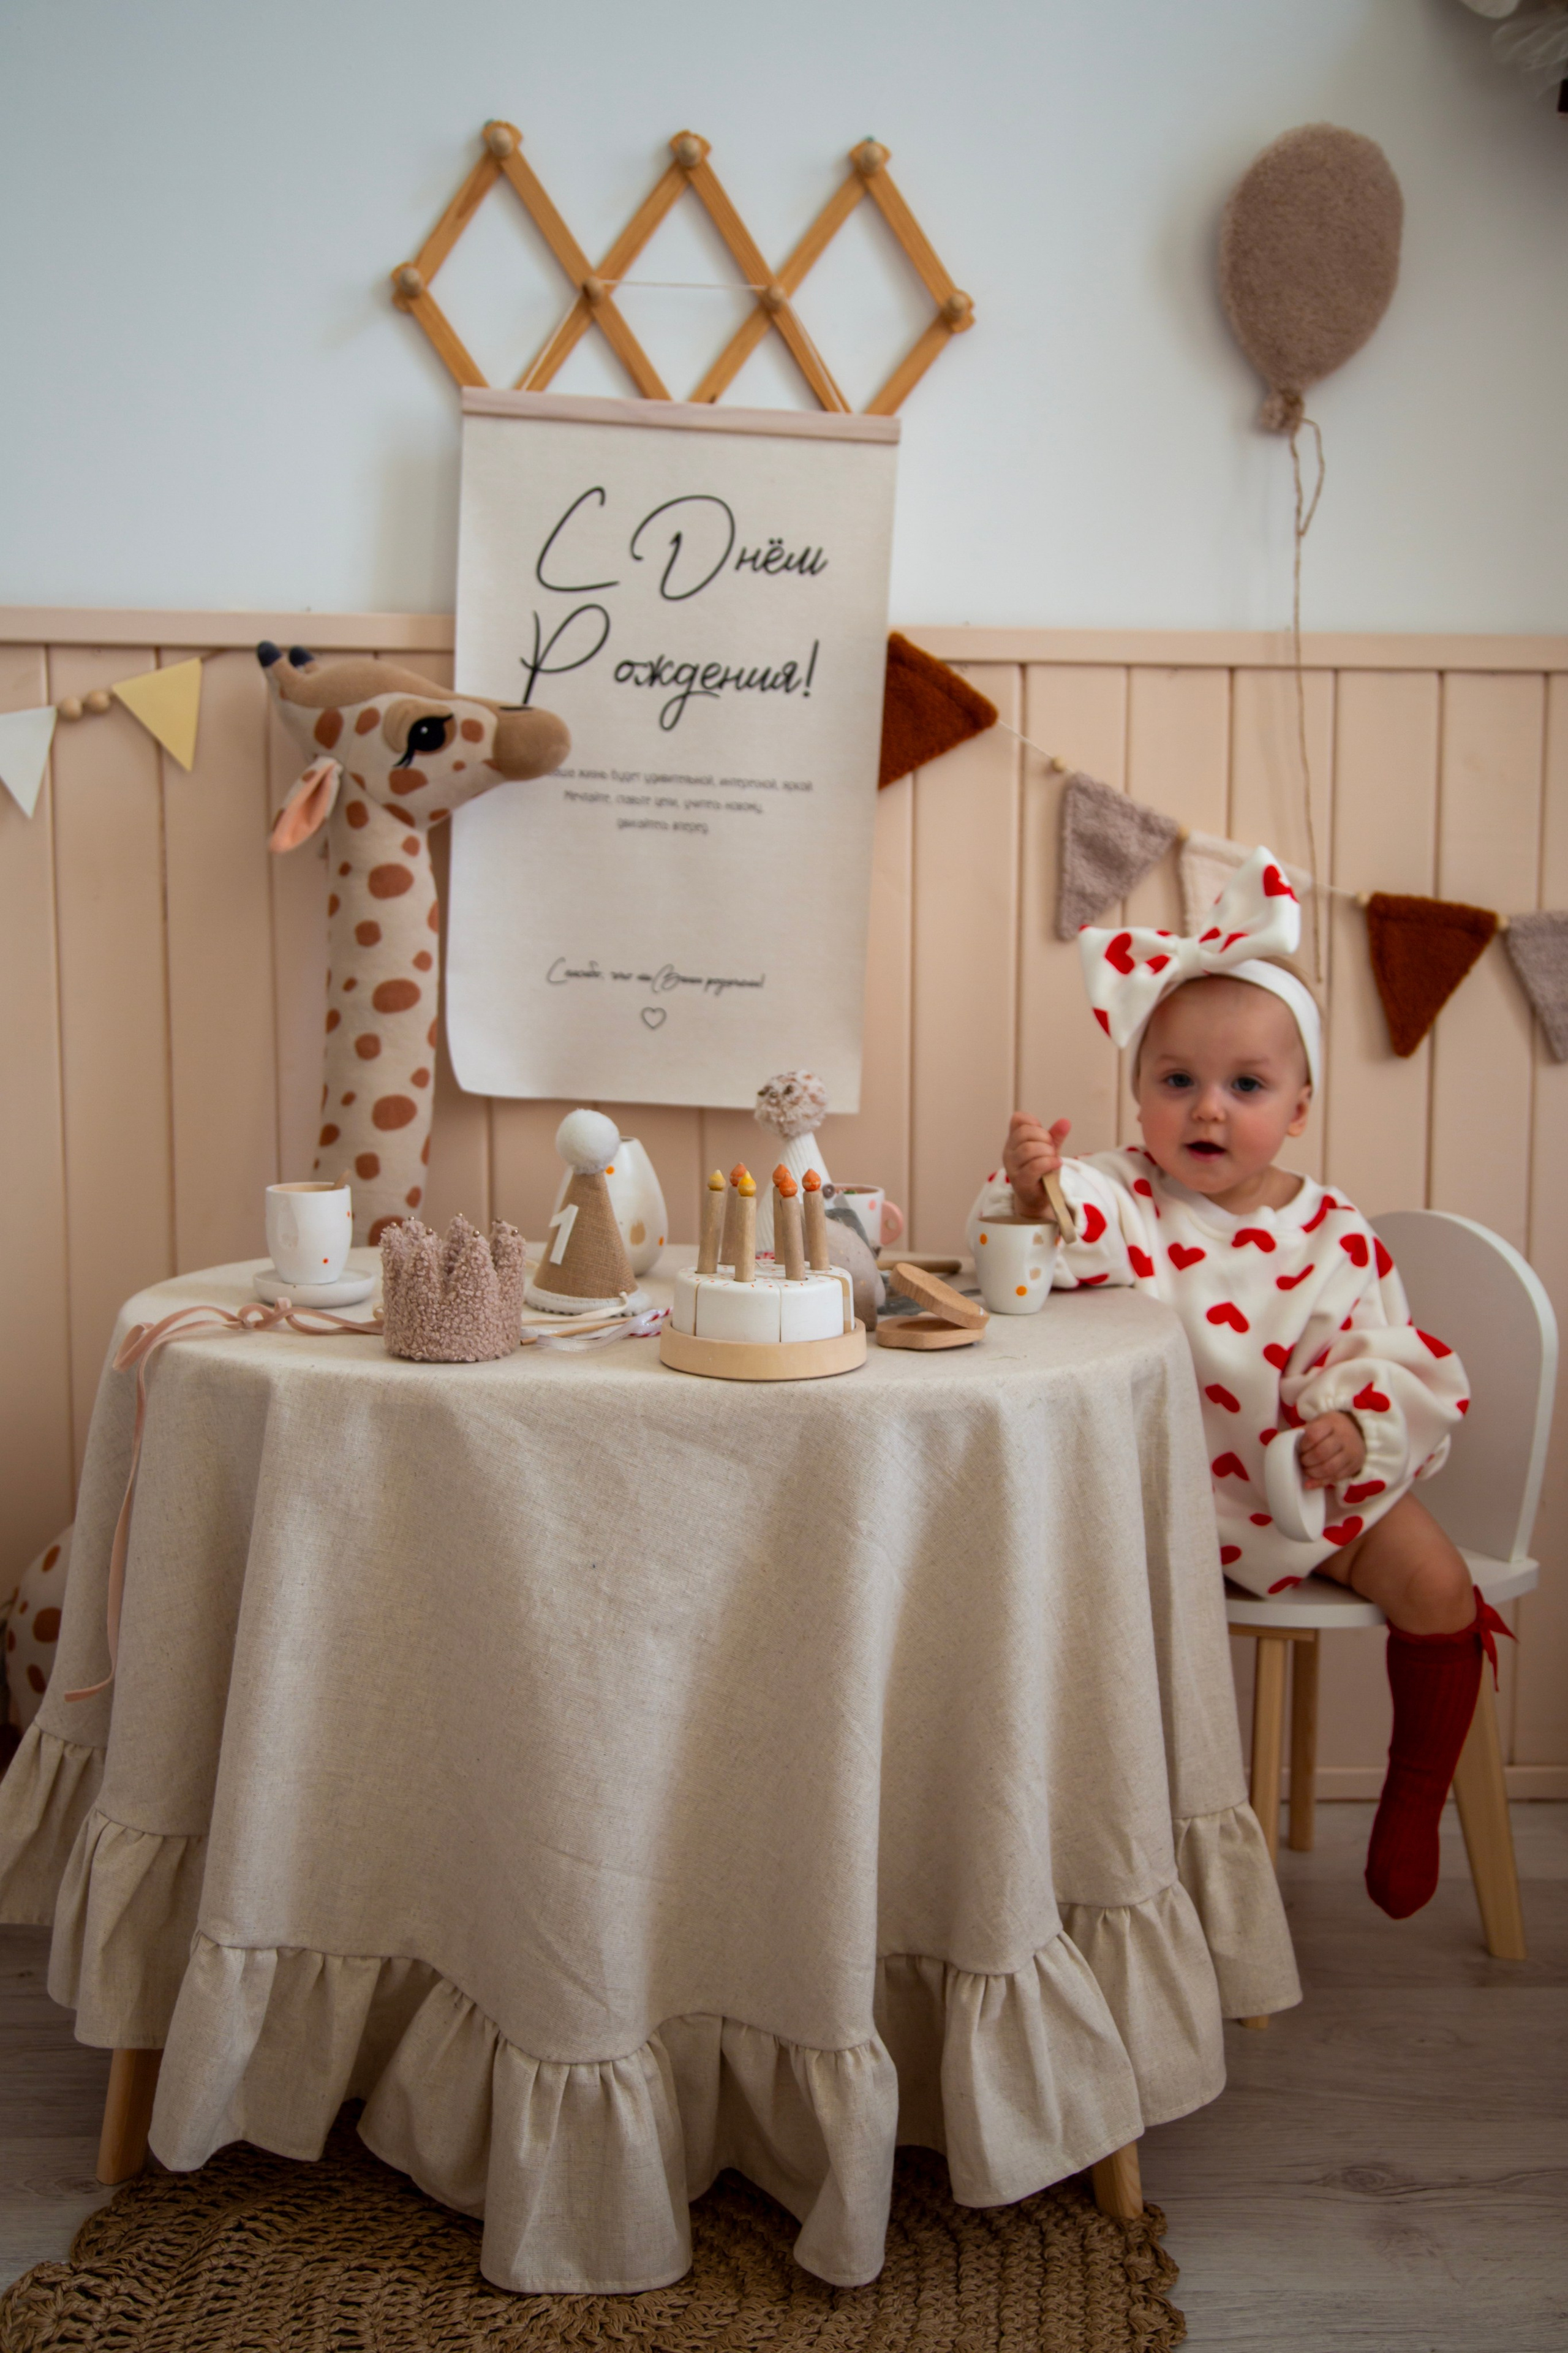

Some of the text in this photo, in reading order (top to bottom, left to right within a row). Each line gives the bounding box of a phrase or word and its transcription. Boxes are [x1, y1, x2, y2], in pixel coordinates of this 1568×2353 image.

[537, 486, 828, 601] С Днём
[521, 604, 819, 731] Рождения!
[549, 1204, 579, 1265] 1
